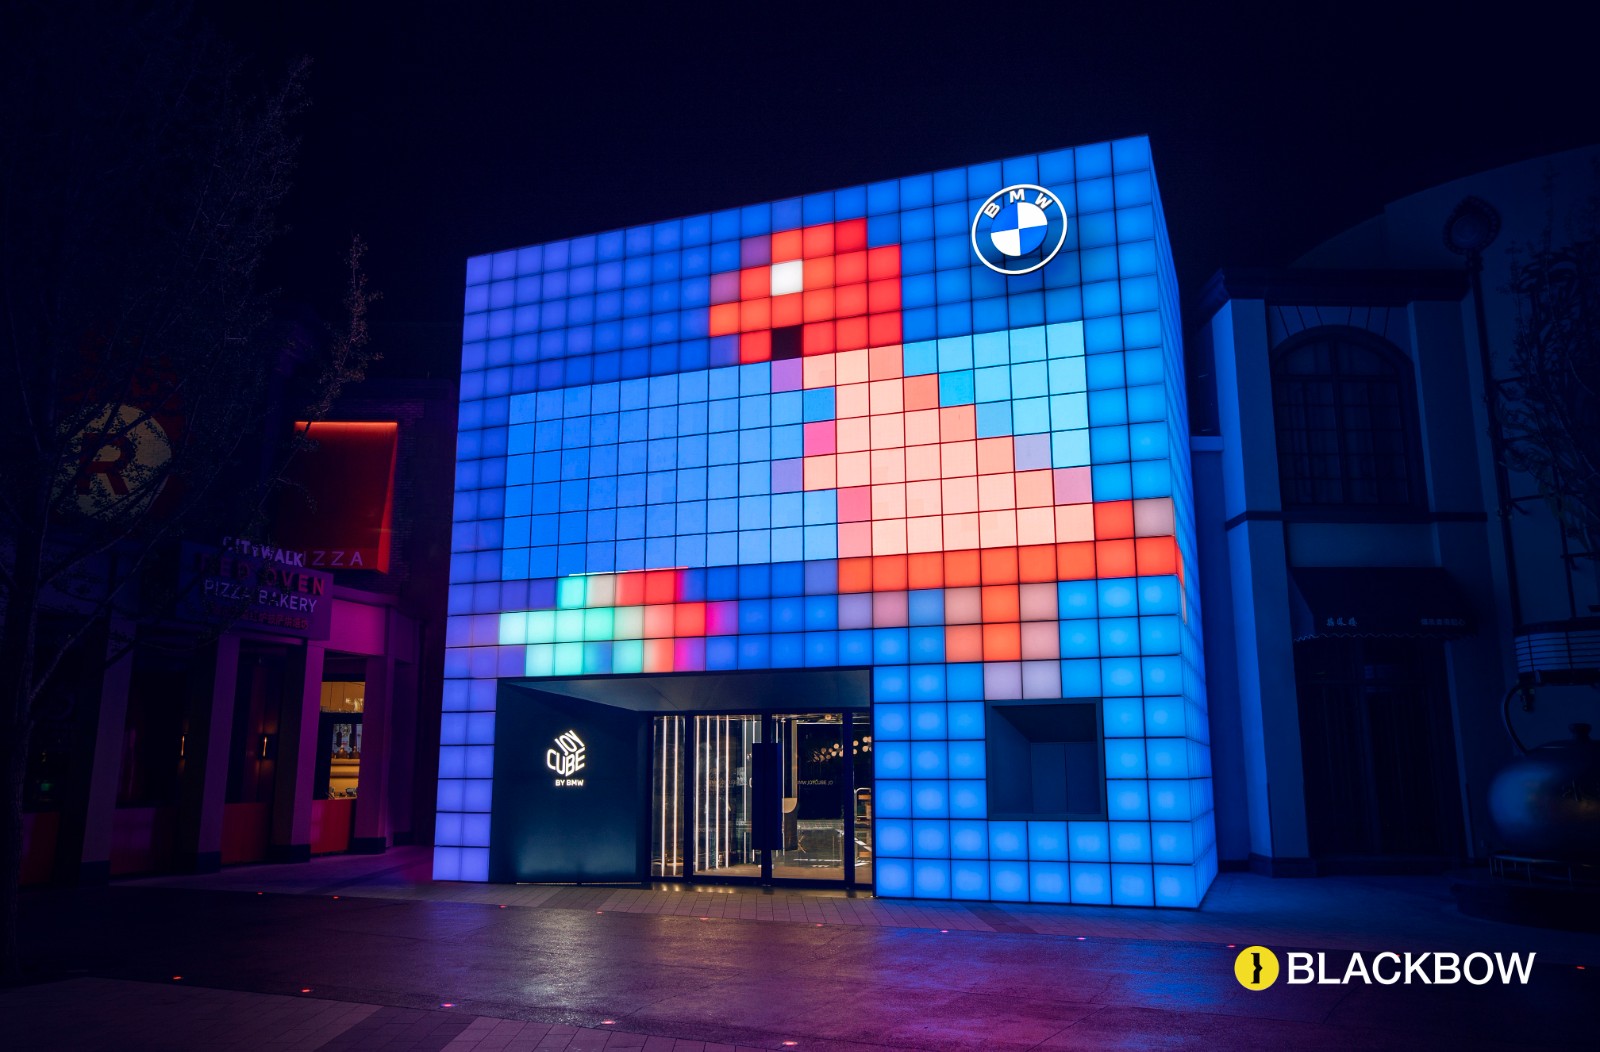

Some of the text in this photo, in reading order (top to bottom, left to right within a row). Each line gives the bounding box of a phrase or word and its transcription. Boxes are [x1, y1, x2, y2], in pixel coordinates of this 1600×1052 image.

[984, 188, 1054, 219] BMW
[77, 432, 129, 495] R
[289, 550, 363, 567] IZZA
[259, 589, 318, 613] BAKERY
[554, 729, 586, 756] JOY
[546, 746, 586, 777] CUBE
[555, 779, 584, 787] BY BMW
